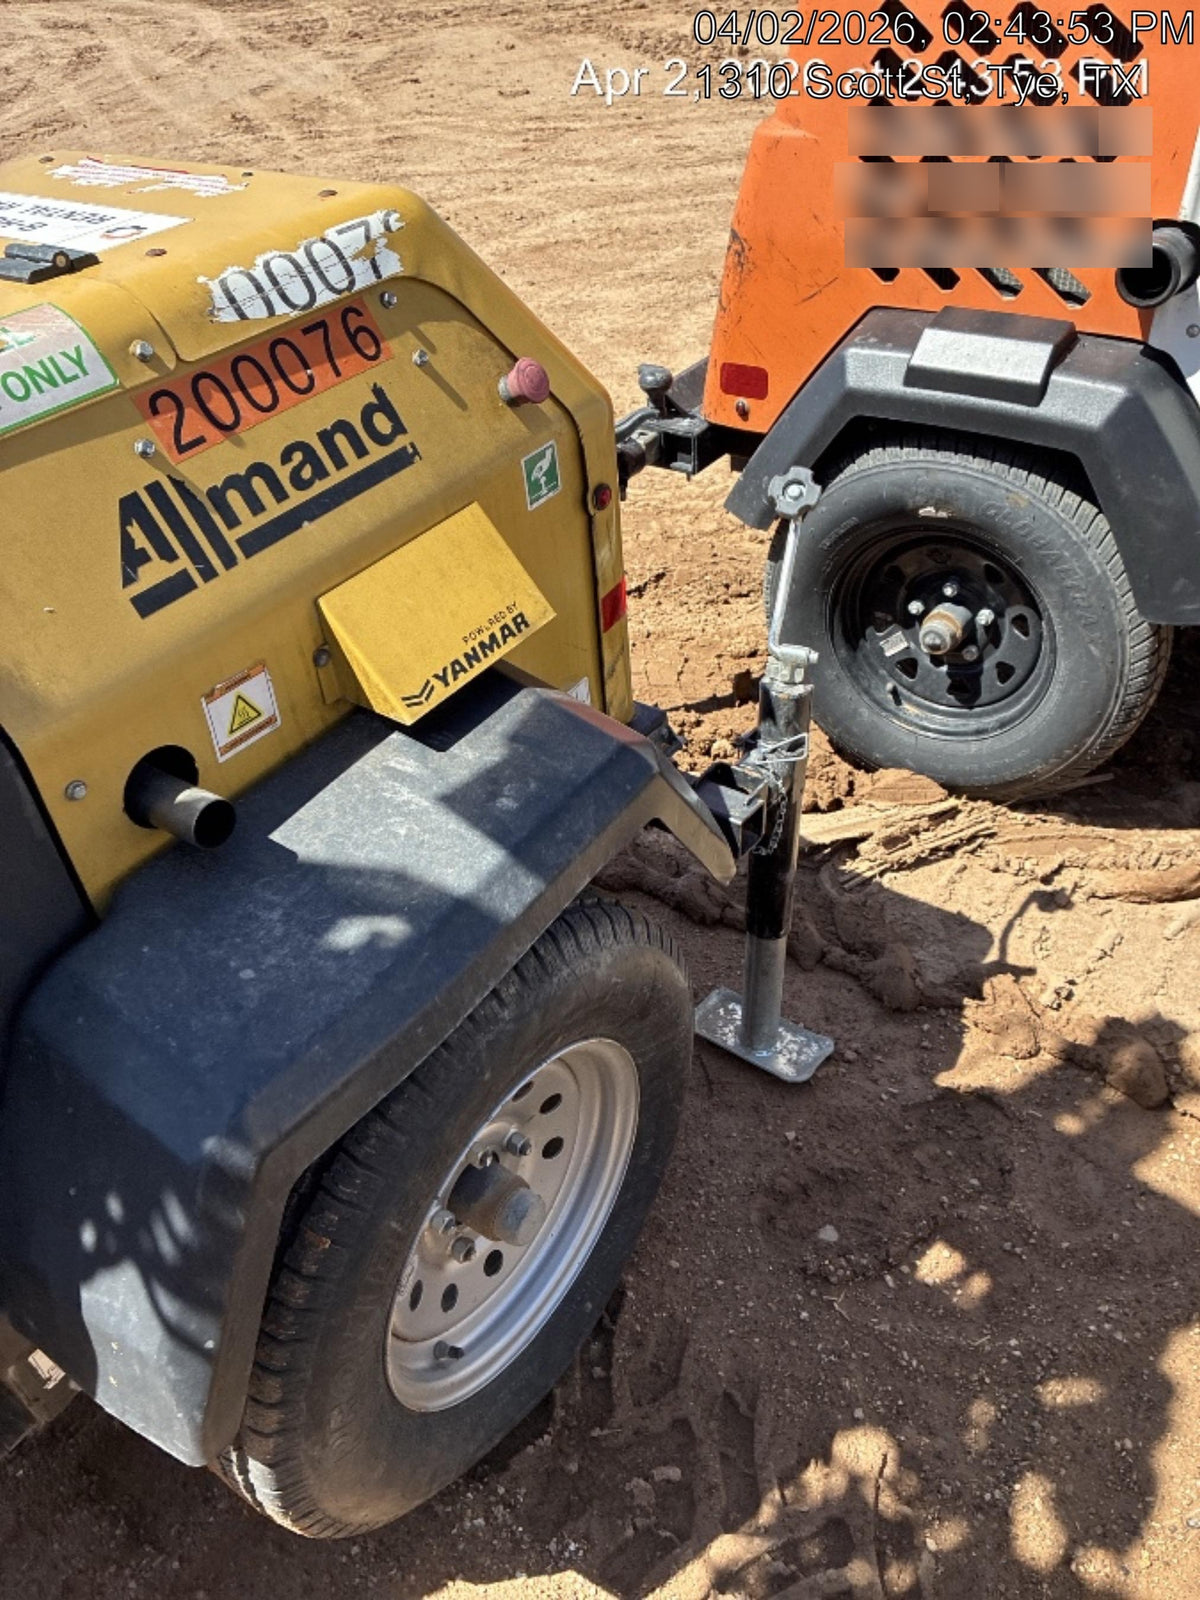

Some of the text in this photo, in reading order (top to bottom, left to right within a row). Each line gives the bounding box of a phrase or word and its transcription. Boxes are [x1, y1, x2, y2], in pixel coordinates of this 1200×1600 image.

[0, 344, 90, 403] ONLY
[148, 306, 383, 456] 200076
[118, 382, 409, 590] Allmand
[432, 611, 530, 688] YANMAR
